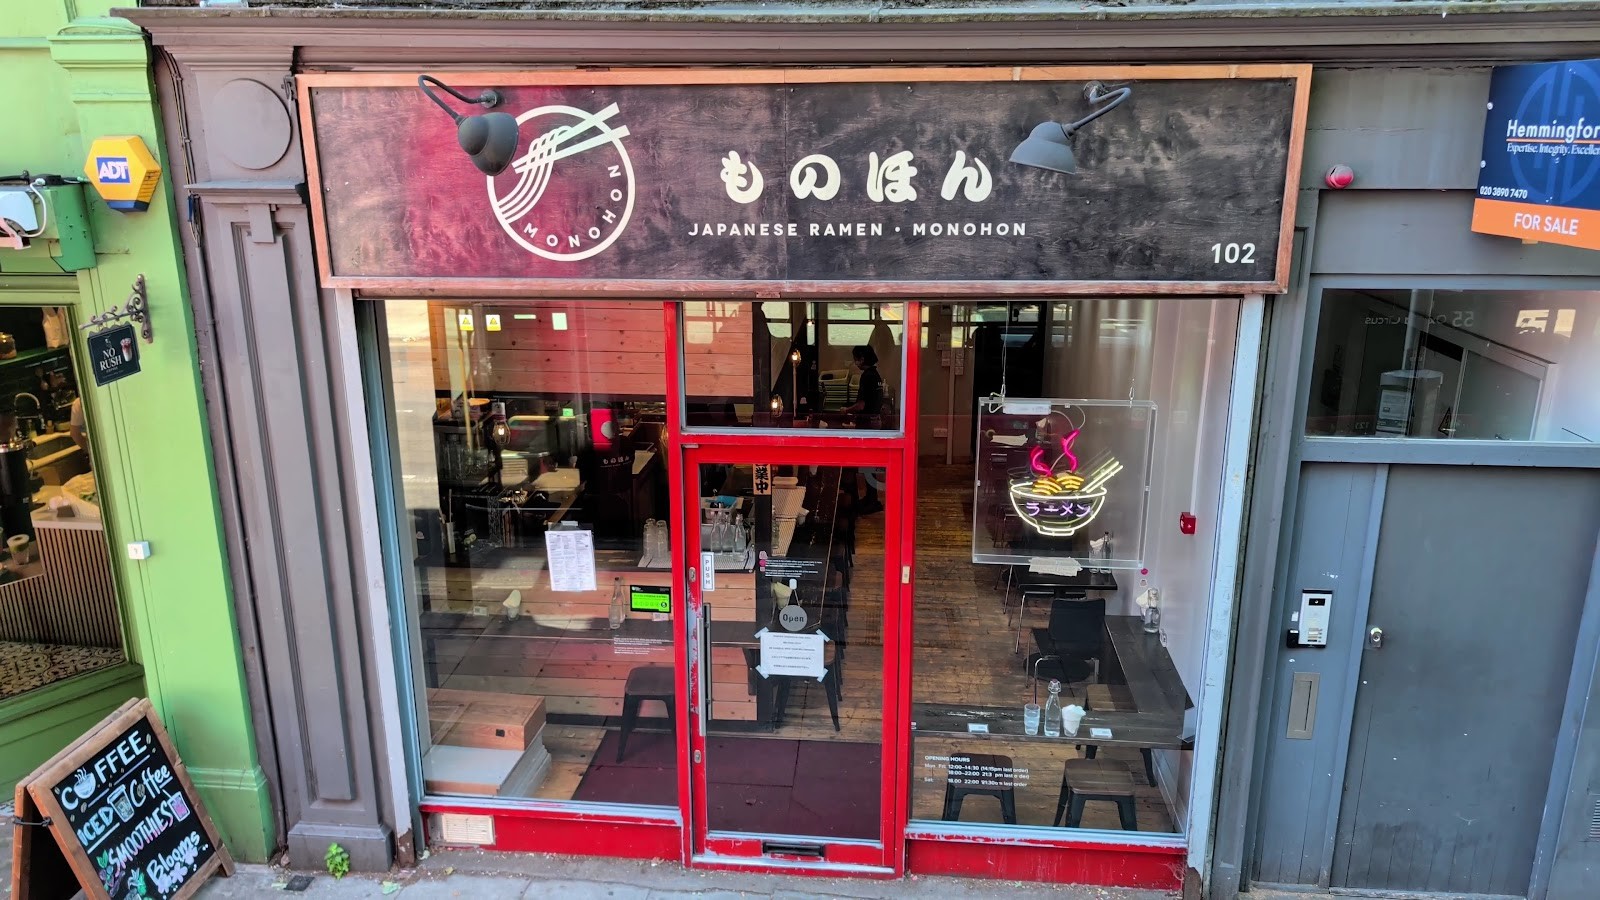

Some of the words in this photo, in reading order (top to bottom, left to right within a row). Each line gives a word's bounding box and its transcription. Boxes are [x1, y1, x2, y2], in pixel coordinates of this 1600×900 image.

[99, 161, 129, 180] ADT
[720, 150, 993, 204] ものほん
[1480, 186, 1492, 195] 020
[1492, 187, 1510, 198] 3890
[1510, 189, 1528, 199] 7470
[523, 165, 623, 248] MONOHON
[688, 223, 798, 237] JAPANESE
[809, 223, 883, 237] RAMEN
[912, 223, 1027, 237] MONOHON
[1514, 212, 1541, 231] FOR
[1544, 216, 1579, 236] SALE
[1211, 242, 1256, 264] 102
[100, 355, 122, 371] RUSH
[103, 347, 116, 360] NO
[755, 464, 769, 493] 業中
[1026, 502, 1091, 518] ラーメン
[782, 613, 805, 623] Open
[77, 806, 114, 847] ICED
[109, 800, 174, 878] SMOOTHIES
[146, 831, 200, 888] Blooms
